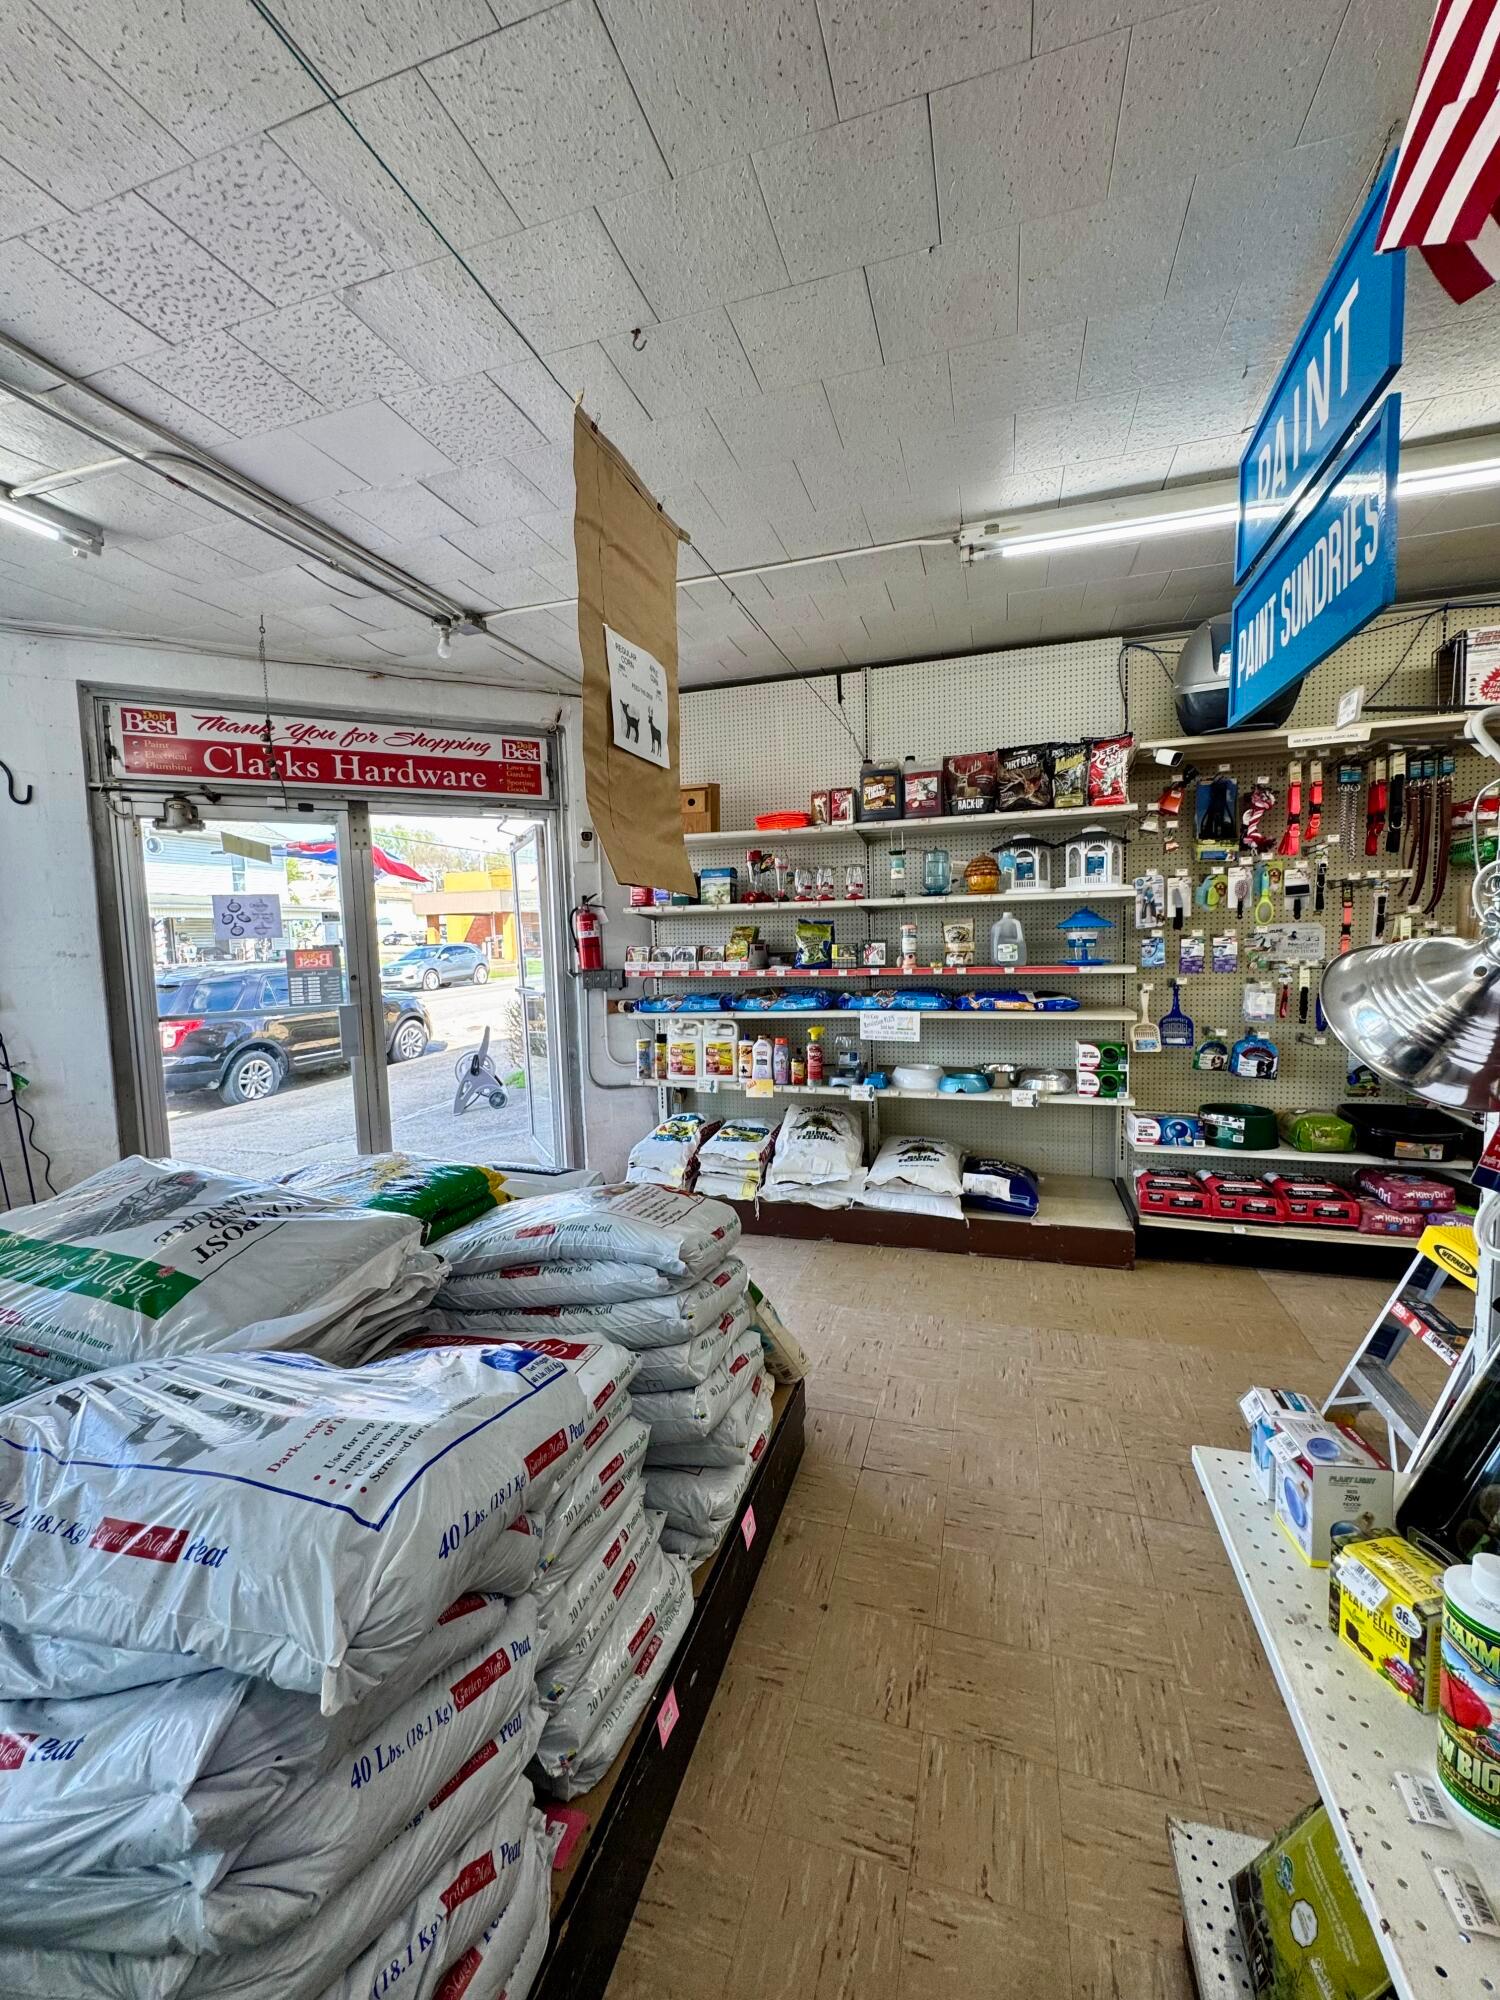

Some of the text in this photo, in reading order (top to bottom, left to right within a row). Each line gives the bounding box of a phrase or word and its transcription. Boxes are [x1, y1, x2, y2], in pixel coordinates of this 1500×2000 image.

[1237, 494, 1380, 689] PAINT SUNDRIES
[123, 711, 176, 734] Best
[143, 740, 170, 749] Paint
[191, 714, 492, 757] Thank You for Shopping
[144, 750, 188, 761] Electrical
[503, 742, 540, 761] Best
[1021, 754, 1037, 766] BAG
[145, 762, 193, 773] Plumbing
[203, 746, 487, 788] Clarks Hardware
[506, 771, 531, 779] Garden
[506, 778, 536, 788] Sporting
[506, 785, 529, 793] Goods
[957, 797, 984, 811] RACK-UP
[798, 1106, 845, 1117] Sunflower
[797, 1134, 836, 1142] FEEDING
[806, 1130, 830, 1138] BIRD
[897, 1138, 947, 1147] Sunflower
[1414, 1190, 1447, 1200] KittyDri
[209, 1206, 248, 1230] AND
[557, 1223, 612, 1233] Potting Soil
[1384, 1213, 1416, 1225] KittyDri
[1440, 1249, 1470, 1273] WERNER
[595, 1305, 612, 1315] Soil
[58, 1327, 77, 1341] and
[77, 1332, 114, 1351] Manure
[324, 1424, 337, 1437] of
[569, 1418, 586, 1444] Peat
[266, 1440, 307, 1474] Dark,
[324, 1421, 376, 1470] Use for top
[339, 1432, 383, 1474] Improves
[354, 1424, 411, 1478] Use to break
[369, 1427, 425, 1483] Screened for
[1344, 1494, 1360, 1502] 75W
[61, 1521, 92, 1545] Kg)
[134, 1532, 178, 1556] Magic
[439, 1523, 460, 1560] 40
[463, 1510, 488, 1539] Lbs.
[184, 1537, 230, 1568] Peat
[634, 1537, 651, 1565] Potting
[1393, 1560, 1437, 1596] PELLETS
[654, 1586, 673, 1618] Potting
[568, 1609, 579, 1625] 20
[659, 1604, 680, 1638] Potting
[1395, 1607, 1409, 1626] 36
[1366, 1610, 1408, 1649] PELLETS
[510, 1636, 532, 1662] Peat
[576, 1638, 588, 1656] 20
[455, 1657, 508, 1705] Garden Magic
[587, 1698, 599, 1718] 20
[499, 1712, 522, 1744] Peat
[602, 1716, 613, 1735] 20
[29, 1735, 86, 1762] Peat
[351, 1702, 453, 1790] 40 Lbs. (18.1 Kg)
[1457, 1748, 1500, 1797] BIG
[499, 1838, 521, 1869] Peat
[372, 1914, 444, 2000] (18.1 Kg)
